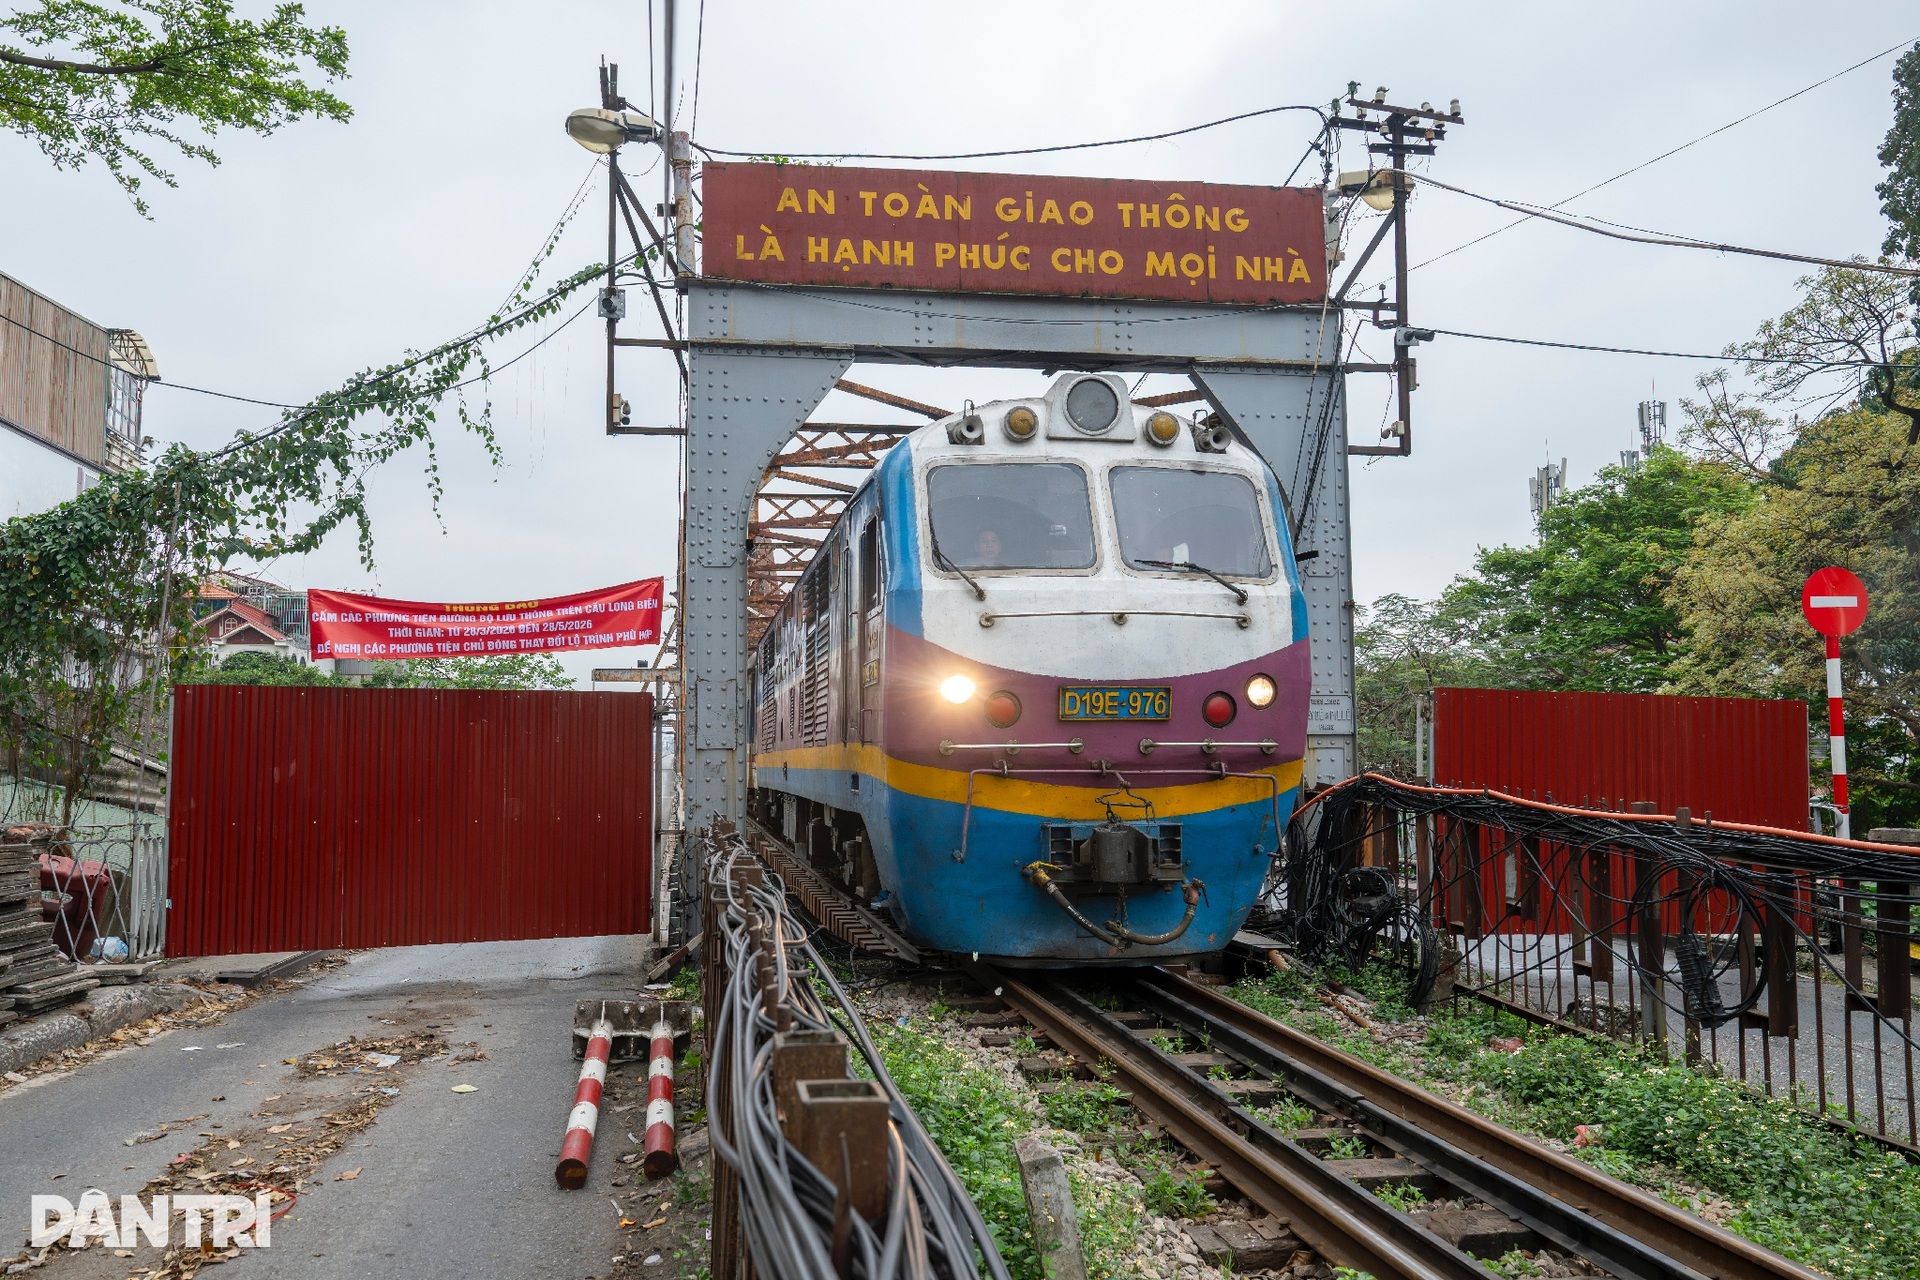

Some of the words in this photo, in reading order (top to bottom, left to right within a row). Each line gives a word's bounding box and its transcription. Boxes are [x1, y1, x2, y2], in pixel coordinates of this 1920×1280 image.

[776, 187, 836, 215] AN
[859, 183, 972, 220] TOÀN
[995, 191, 1095, 226] GIAO
[1117, 193, 1250, 233] THÔNG
[735, 224, 786, 262] LÀ
[807, 235, 915, 272] HẠNH
[934, 232, 1031, 271] PHÚC
[1051, 247, 1125, 276] CHO
[1144, 245, 1217, 287] MỌI
[1235, 247, 1312, 284] NHÀ
[341, 611, 363, 622] CÁC
[365, 612, 410, 623] PHƯƠNG
[412, 614, 437, 624] TIỆN
[608, 601, 635, 612] LONG
[415, 627, 444, 638] GIAN:
[463, 625, 515, 637] 28/3/2026
[542, 619, 593, 632] 28/5/2026
[334, 643, 361, 656] NGHỊ
[364, 642, 386, 654] CÁC
[389, 642, 434, 653] PHƯƠNG
[436, 641, 460, 654] TIỆN
[463, 638, 485, 652] CHỦ
[519, 637, 545, 649] THAY
[1064, 691, 1167, 716] D19E-976
